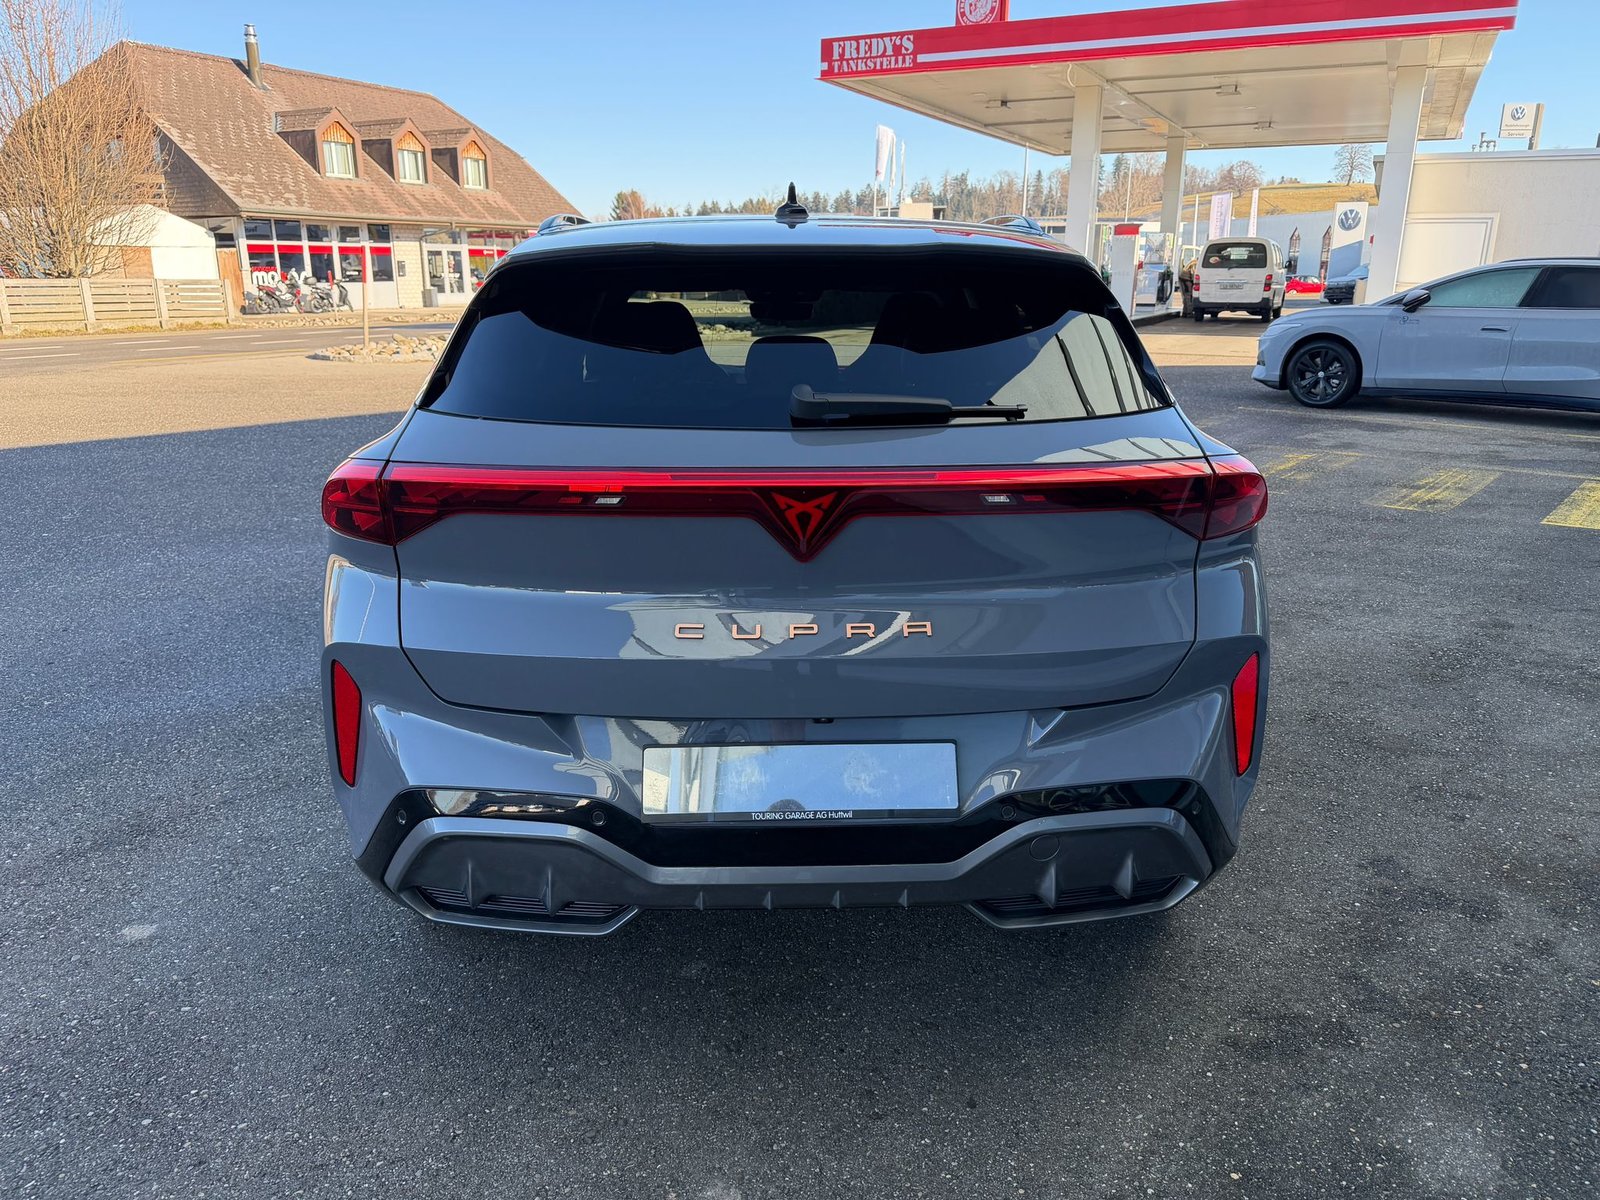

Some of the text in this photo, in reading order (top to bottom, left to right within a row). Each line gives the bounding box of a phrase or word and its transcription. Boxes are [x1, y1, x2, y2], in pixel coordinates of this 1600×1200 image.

[832, 35, 914, 60] FREDY'S
[832, 55, 913, 73] TANKSTELLE
[674, 621, 932, 639] CUPRA
[751, 810, 853, 820] TOURING GARAGE AG Huttwil
